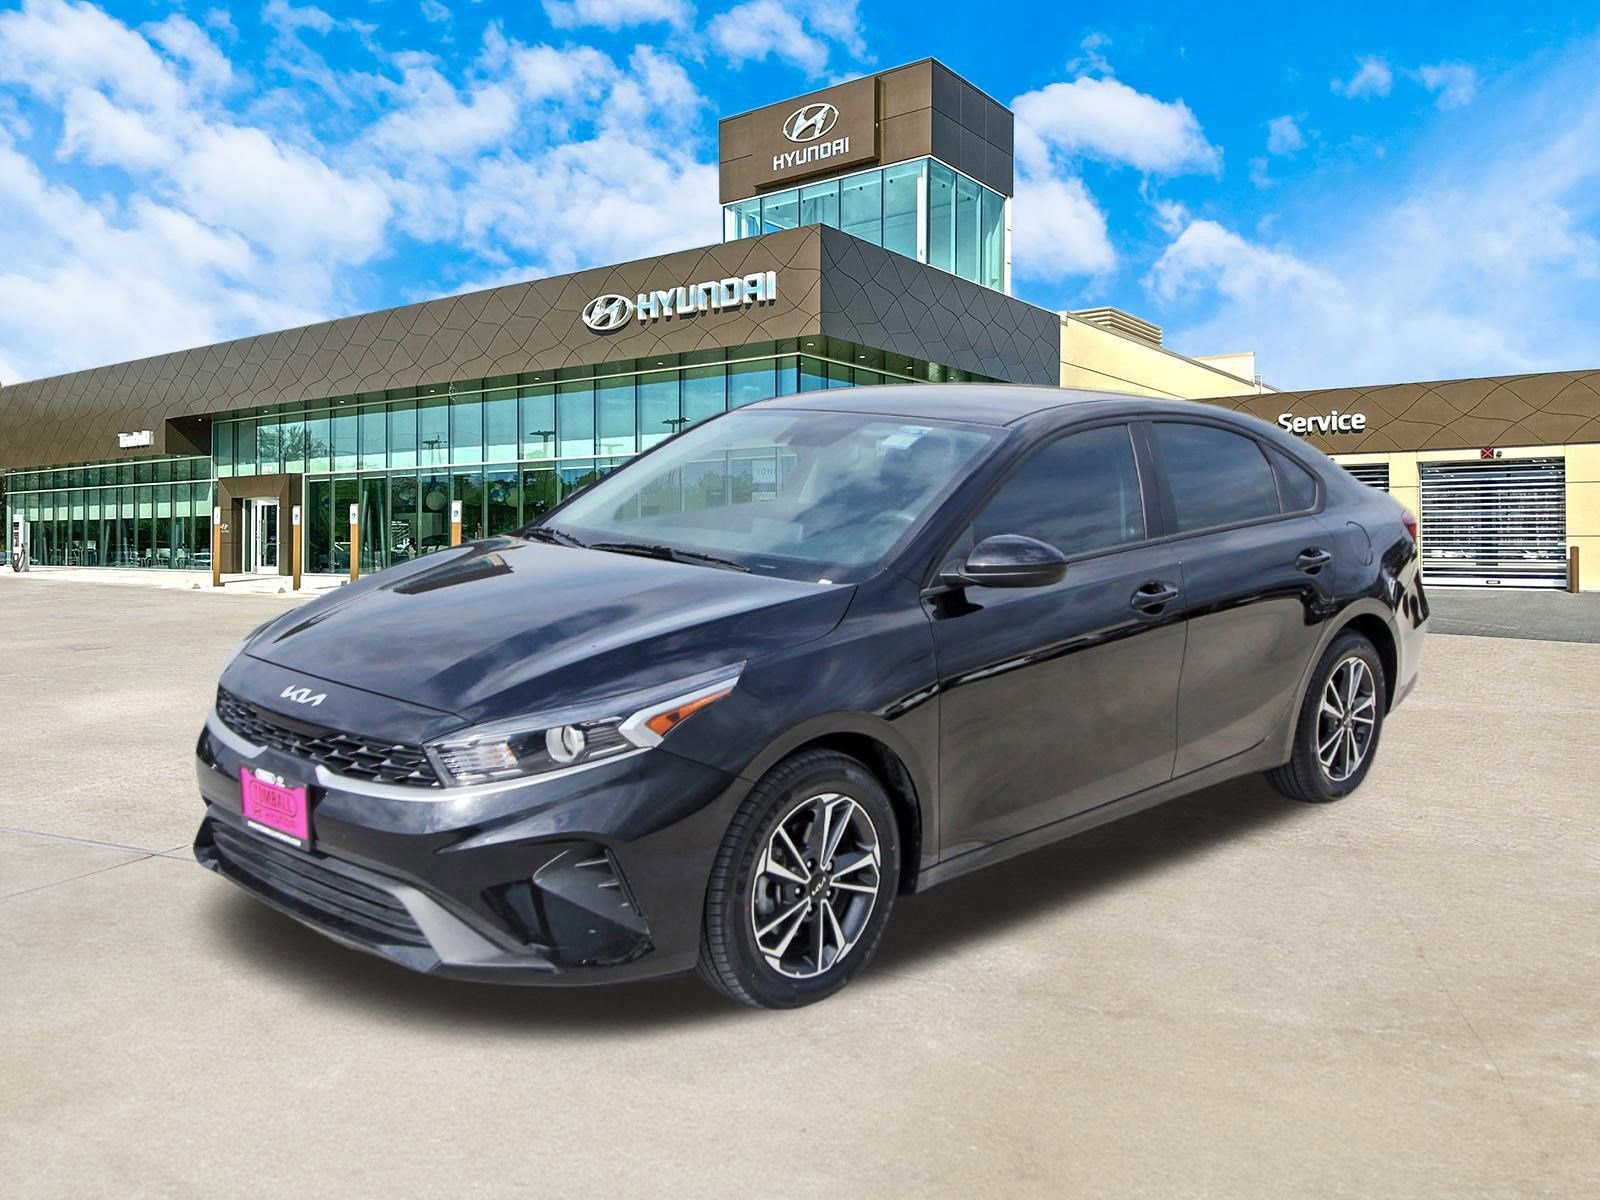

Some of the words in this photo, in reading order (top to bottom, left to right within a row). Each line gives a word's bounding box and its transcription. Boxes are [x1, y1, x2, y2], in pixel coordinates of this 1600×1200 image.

[773, 137, 850, 171] HYUNDAI
[637, 270, 777, 321] HYUNDAI
[1278, 410, 1367, 433] Service
